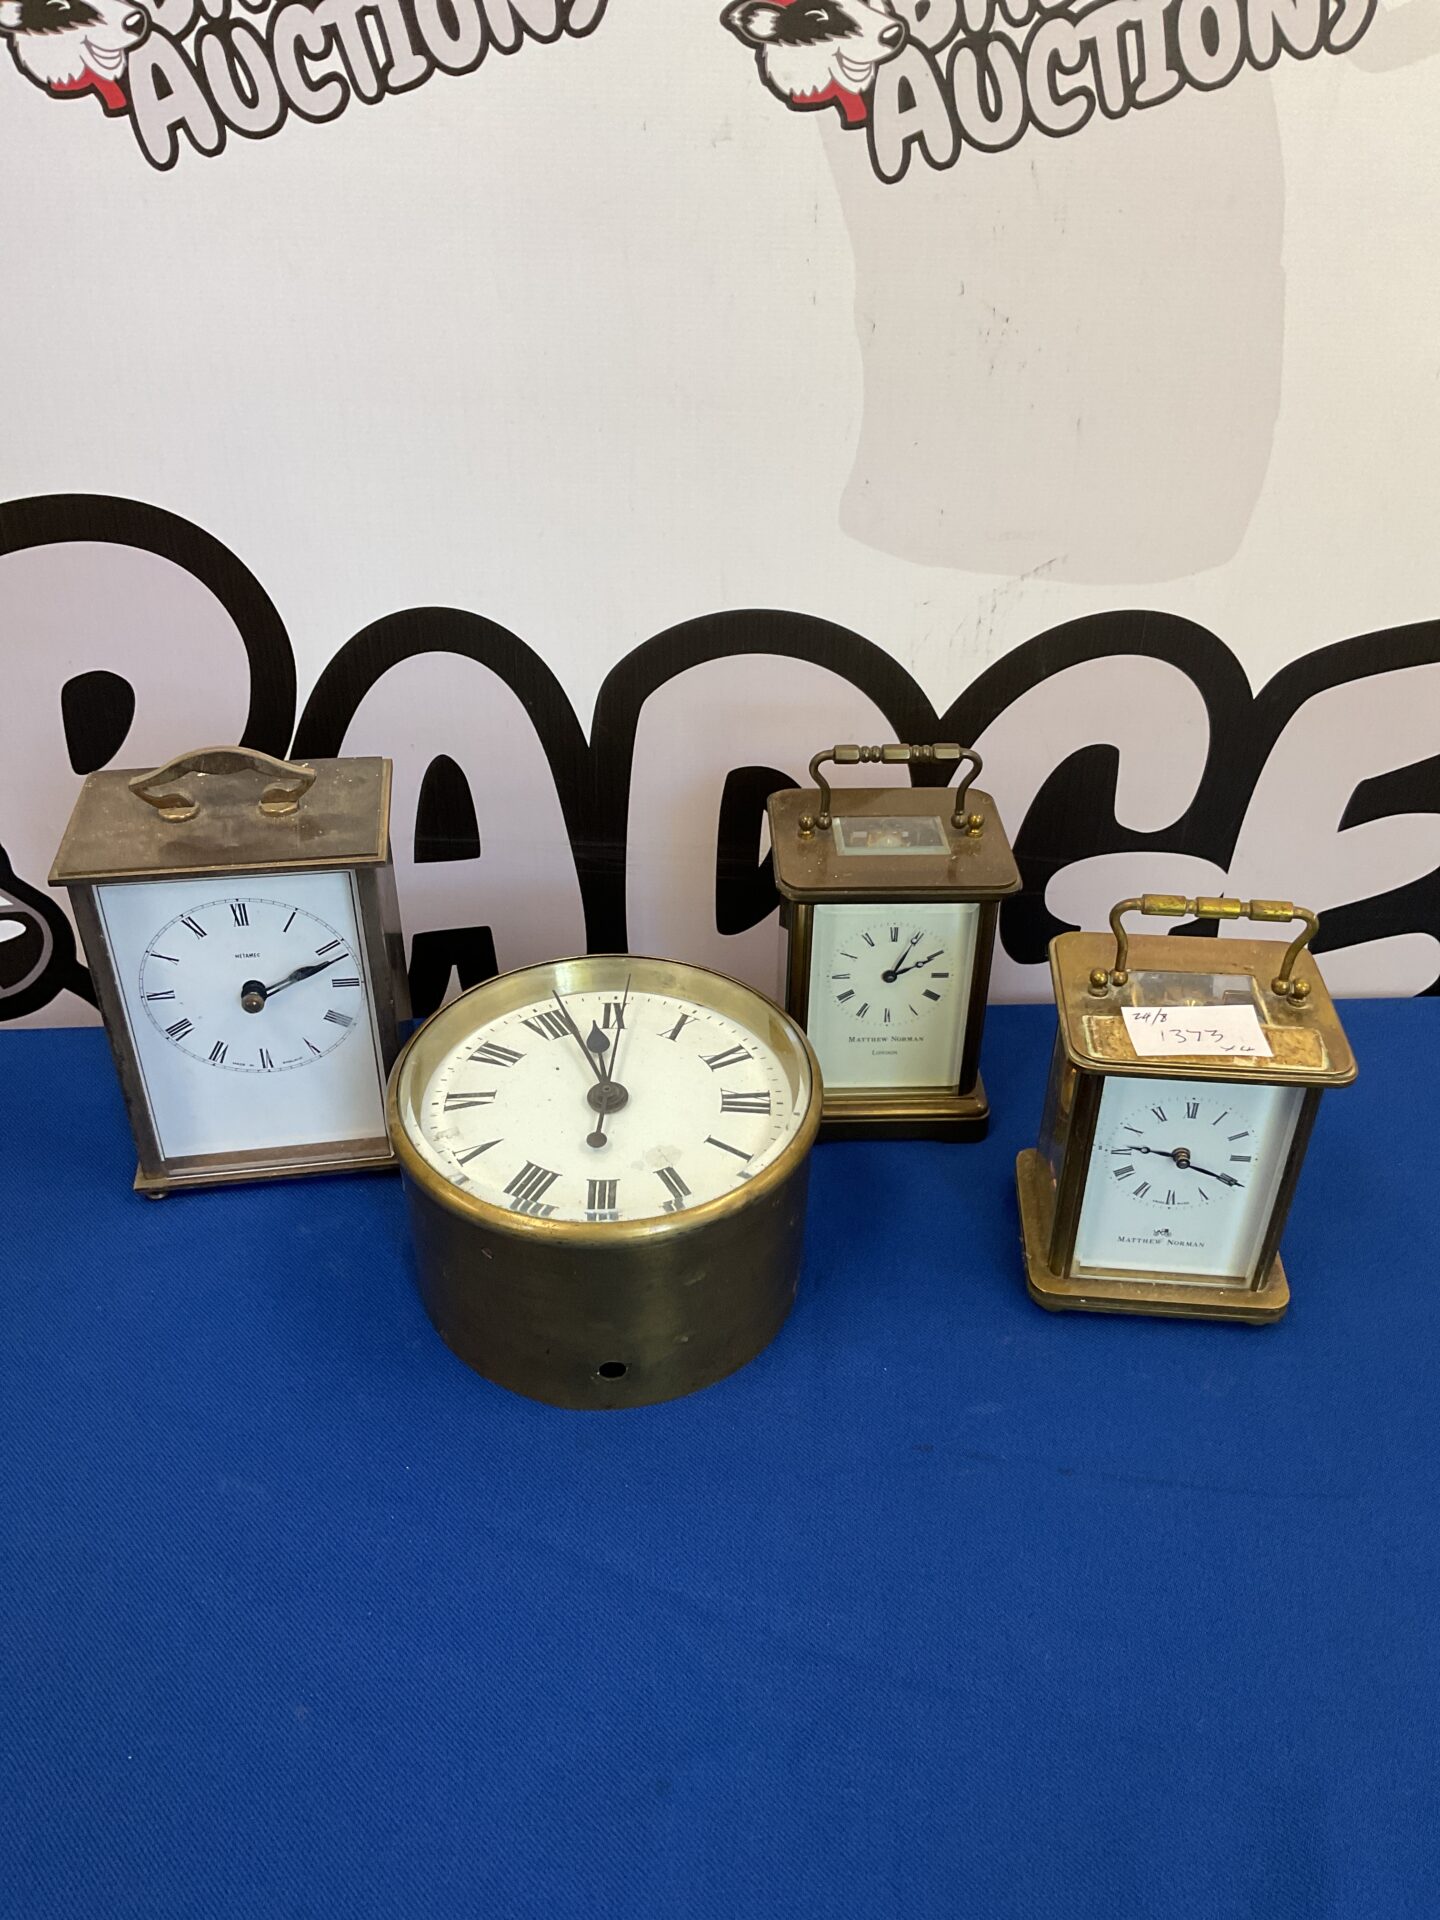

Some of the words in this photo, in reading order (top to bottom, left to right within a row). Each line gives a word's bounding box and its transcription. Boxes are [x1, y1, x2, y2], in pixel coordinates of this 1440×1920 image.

[128, 0, 608, 172] AUCTION
[866, 0, 1378, 184] AUCTION
[230, 903, 249, 927] XII
[283, 911, 296, 933] I
[181, 916, 207, 940] XI
[150, 951, 180, 965] X
[315, 939, 341, 956] II
[331, 978, 360, 988] III
[146, 990, 176, 1001] IX
[165, 1018, 195, 1041] VIII
[323, 1009, 353, 1027] IIII
[657, 1013, 699, 1042] X
[302, 1037, 321, 1054] V
[1160, 1029, 1224, 1044] 1373
[208, 1040, 228, 1063] VII
[259, 1048, 274, 1068] VI
[467, 1041, 527, 1068] VII
[698, 1044, 753, 1072] XI
[443, 1089, 498, 1112] VI
[720, 1088, 771, 1115] XII
[453, 1138, 505, 1167] V
[704, 1135, 754, 1162] I
[503, 1160, 562, 1201] IIII
[653, 1166, 692, 1199] II
[587, 1179, 620, 1210] III
[1117, 1235, 1162, 1245] MATTHEW
[1166, 1238, 1206, 1248] NORMAN
